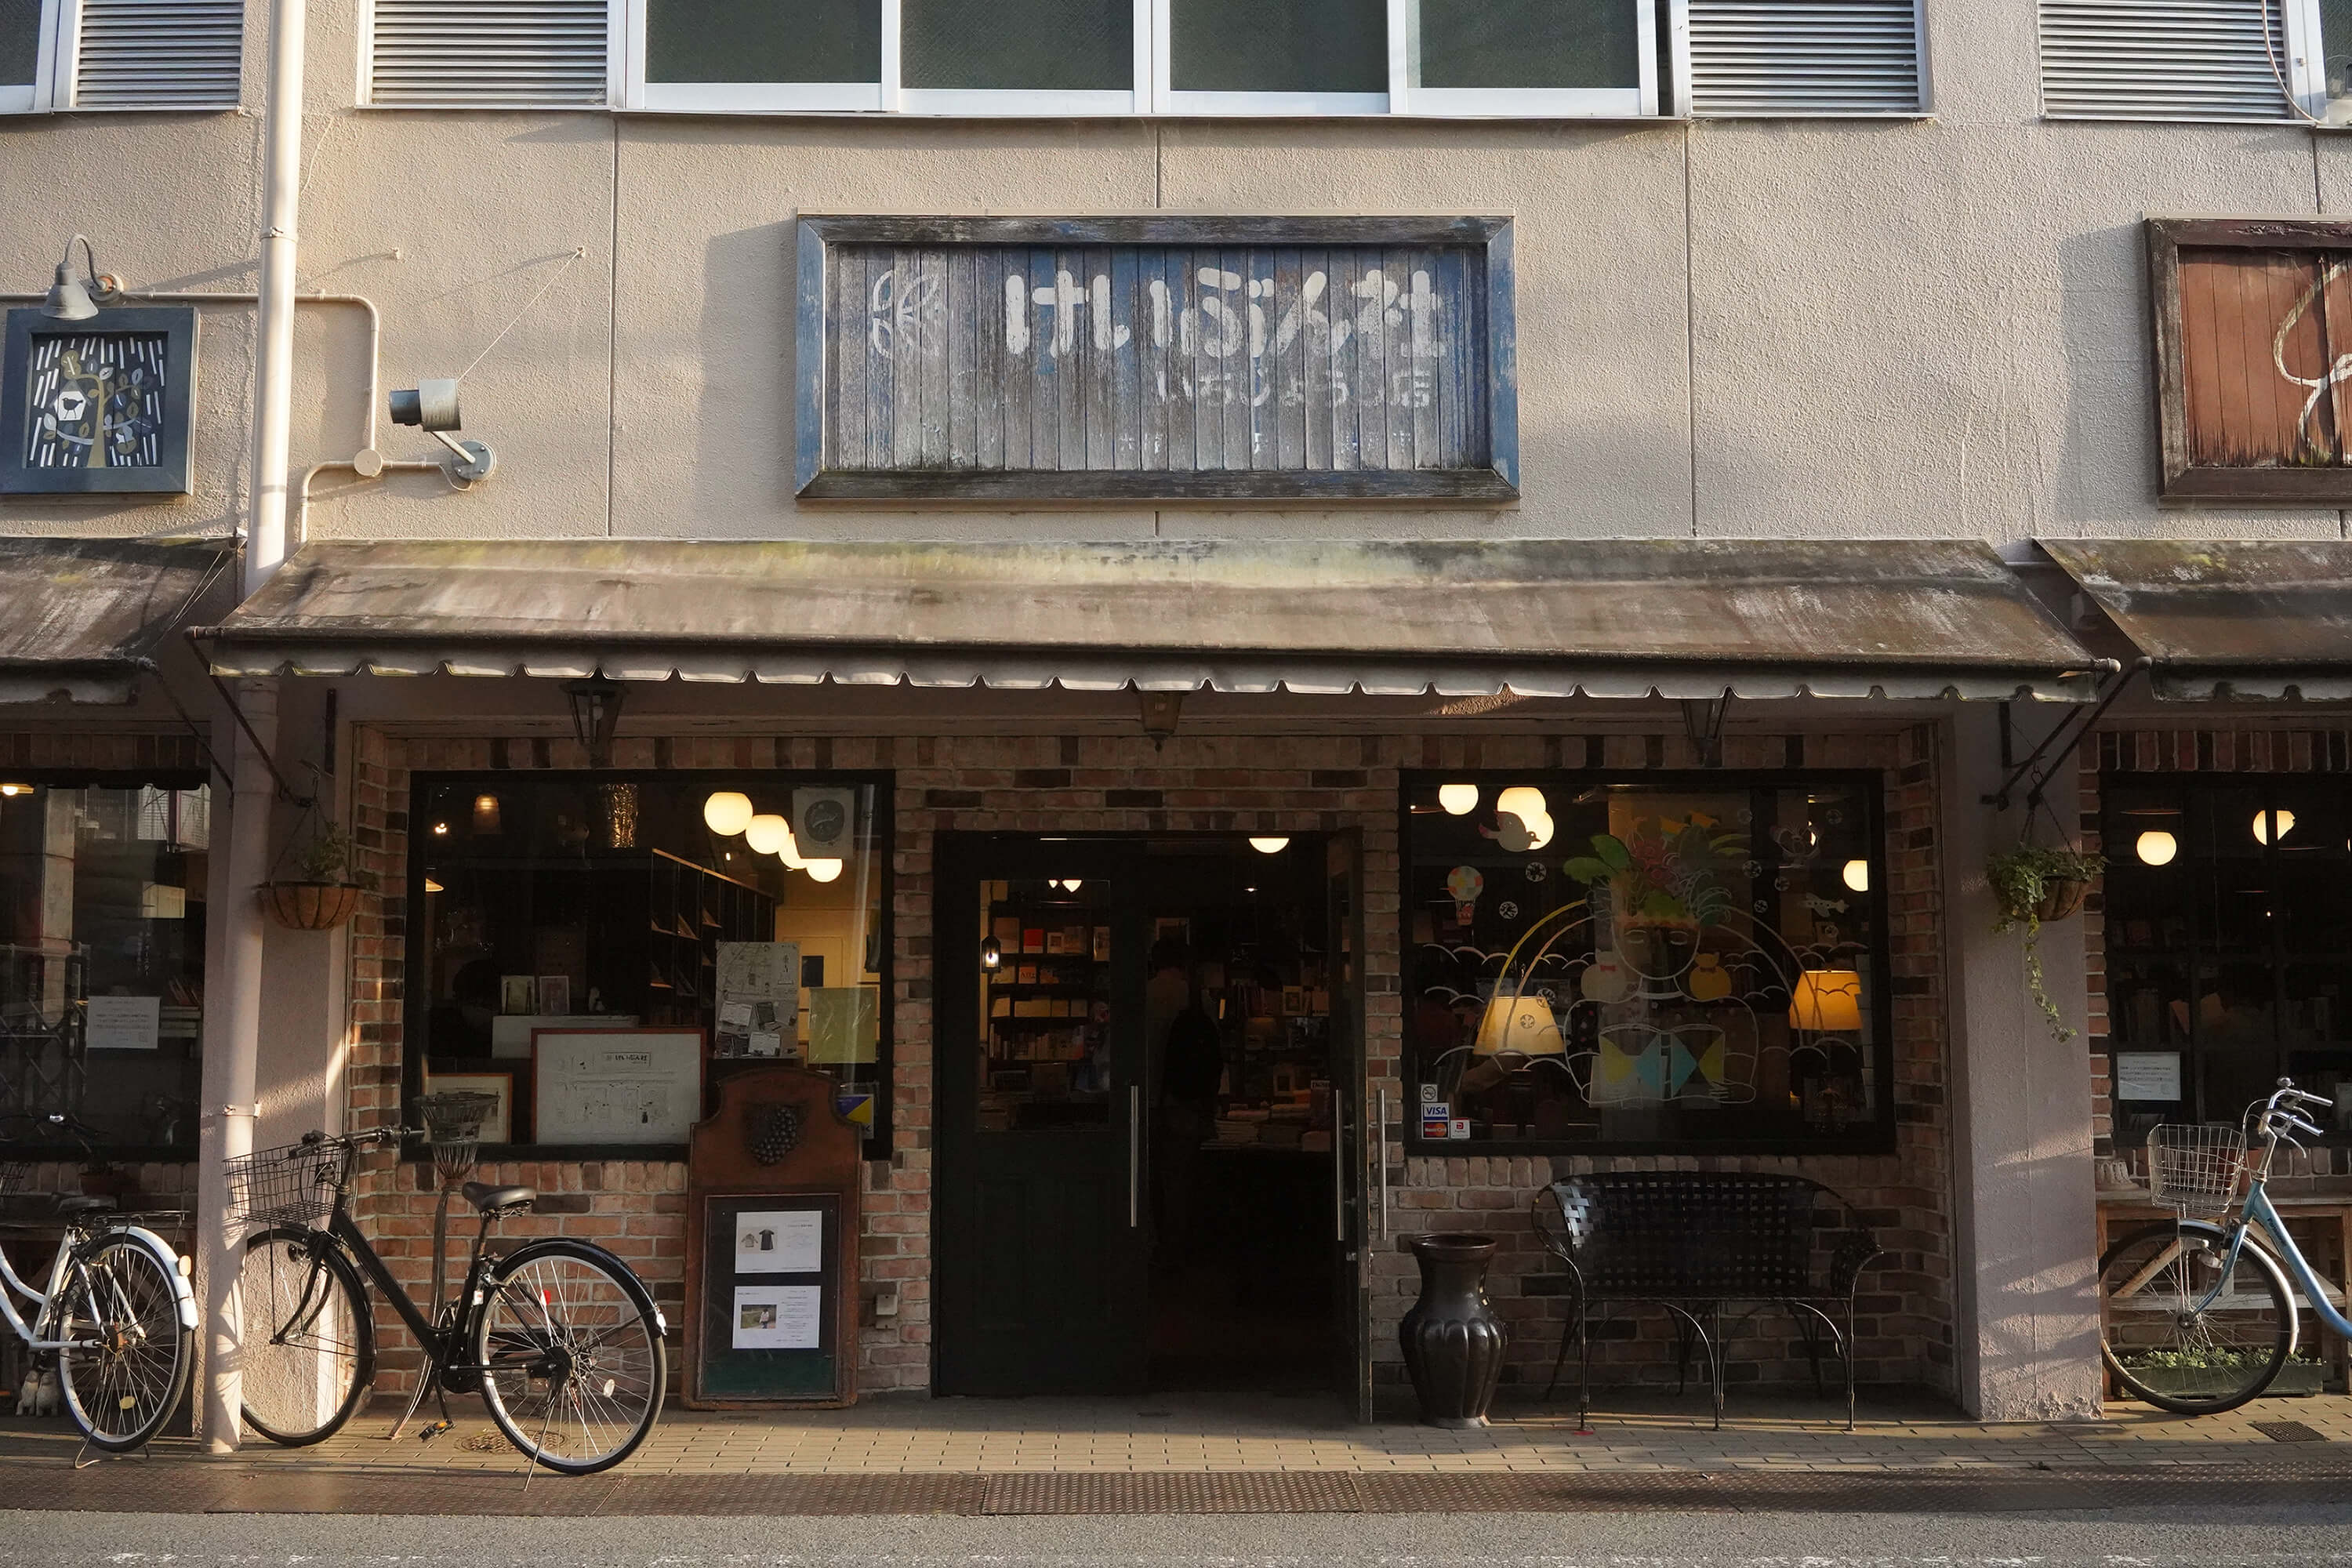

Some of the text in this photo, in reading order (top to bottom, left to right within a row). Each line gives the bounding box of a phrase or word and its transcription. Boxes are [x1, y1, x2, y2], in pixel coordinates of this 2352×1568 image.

[1005, 267, 1447, 359] けいぶん社
